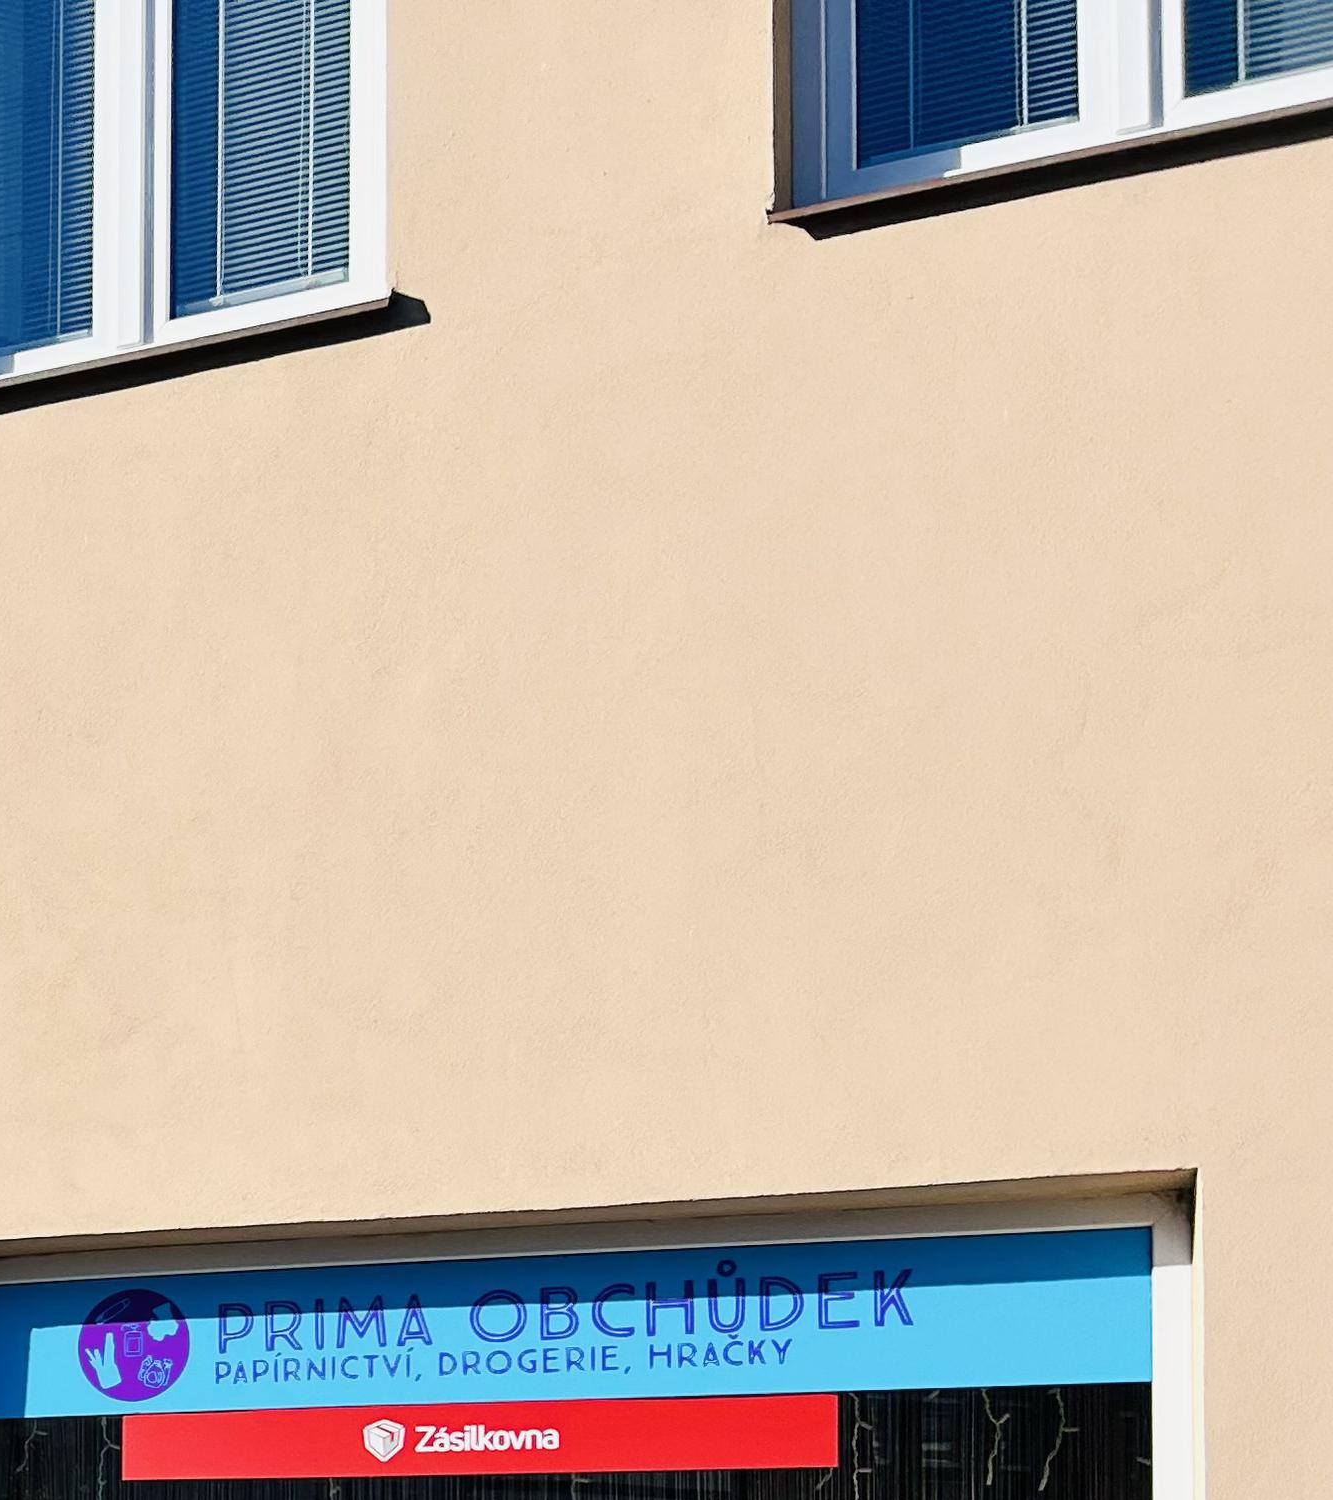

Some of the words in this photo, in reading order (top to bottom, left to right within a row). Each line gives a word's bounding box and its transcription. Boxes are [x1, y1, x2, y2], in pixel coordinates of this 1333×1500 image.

[217, 1292, 433, 1355] PRIMA
[469, 1259, 914, 1343] OBCHŮDEK
[215, 1347, 422, 1385] PAPÍRNICTVÍ,
[438, 1344, 632, 1378] DROGERIE,
[649, 1334, 793, 1370] HRAČKY
[414, 1424, 560, 1453] Zásilkovna
